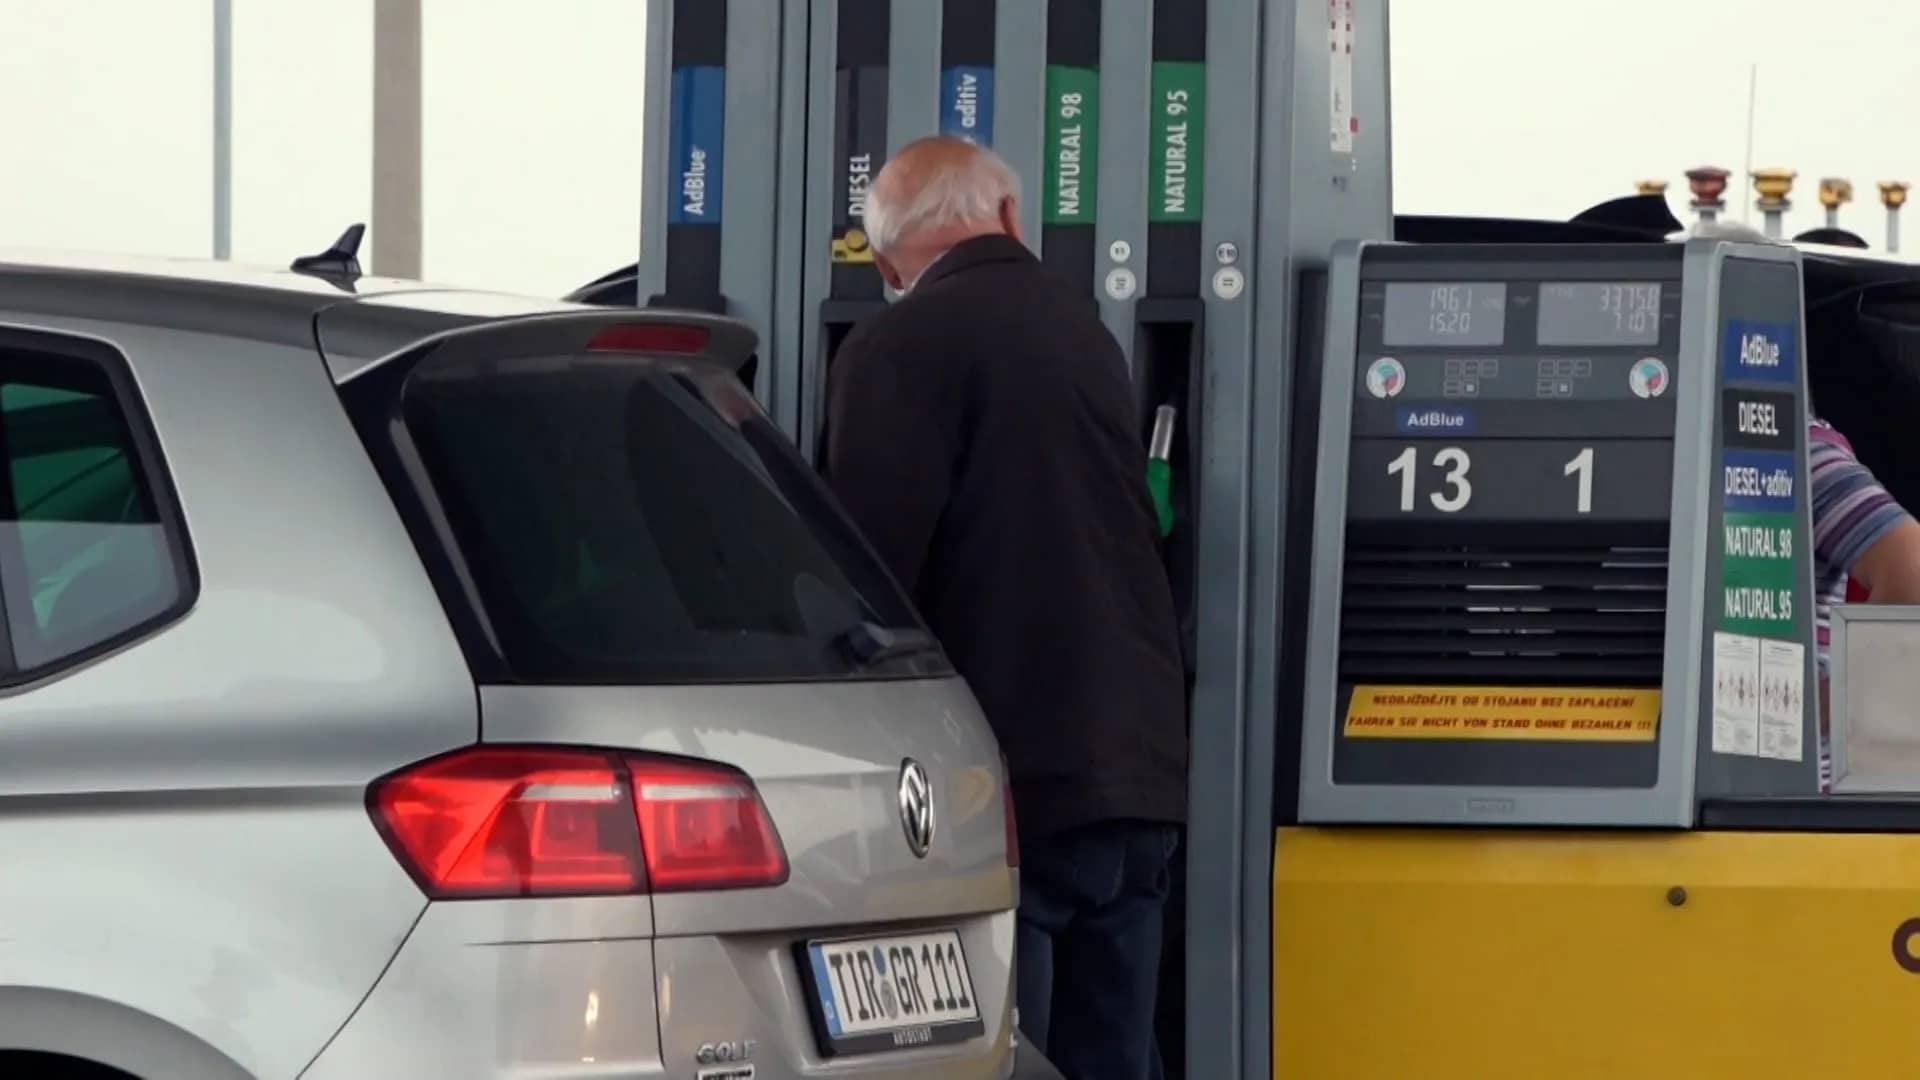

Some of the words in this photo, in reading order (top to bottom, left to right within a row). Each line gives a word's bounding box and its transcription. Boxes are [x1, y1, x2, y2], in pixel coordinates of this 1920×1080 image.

[954, 73, 977, 128] aditiv
[1061, 92, 1083, 119] 98
[1166, 89, 1188, 116] 95
[684, 147, 706, 216] AdBlue
[1058, 124, 1082, 215] NATURAL
[1164, 121, 1187, 213] NATURAL
[848, 153, 871, 216] DIESEL
[1739, 334, 1780, 368] AdBlue
[1406, 412, 1464, 428] AdBlue
[1738, 401, 1779, 436] DIESEL
[1387, 446, 1473, 513] 13
[1563, 446, 1594, 513] 1
[1724, 465, 1793, 498] DIESEL+aditiv
[1724, 526, 1776, 558] NATURAL
[1779, 528, 1792, 560] 98
[1724, 587, 1776, 619] NATURAL
[1778, 589, 1792, 620] 95
[1541, 697, 1563, 707] BEZ
[1349, 716, 1394, 727] FAHREN
[1422, 717, 1458, 728] NICHT
[1463, 718, 1488, 728] VON
[1491, 718, 1530, 729] STAND
[1535, 719, 1566, 729] OHNE
[1571, 719, 1633, 730] BEZAHLEN
[828, 950, 885, 1023] TIR
[921, 943, 970, 1012] 111
[696, 1040, 757, 1064] GOLF
